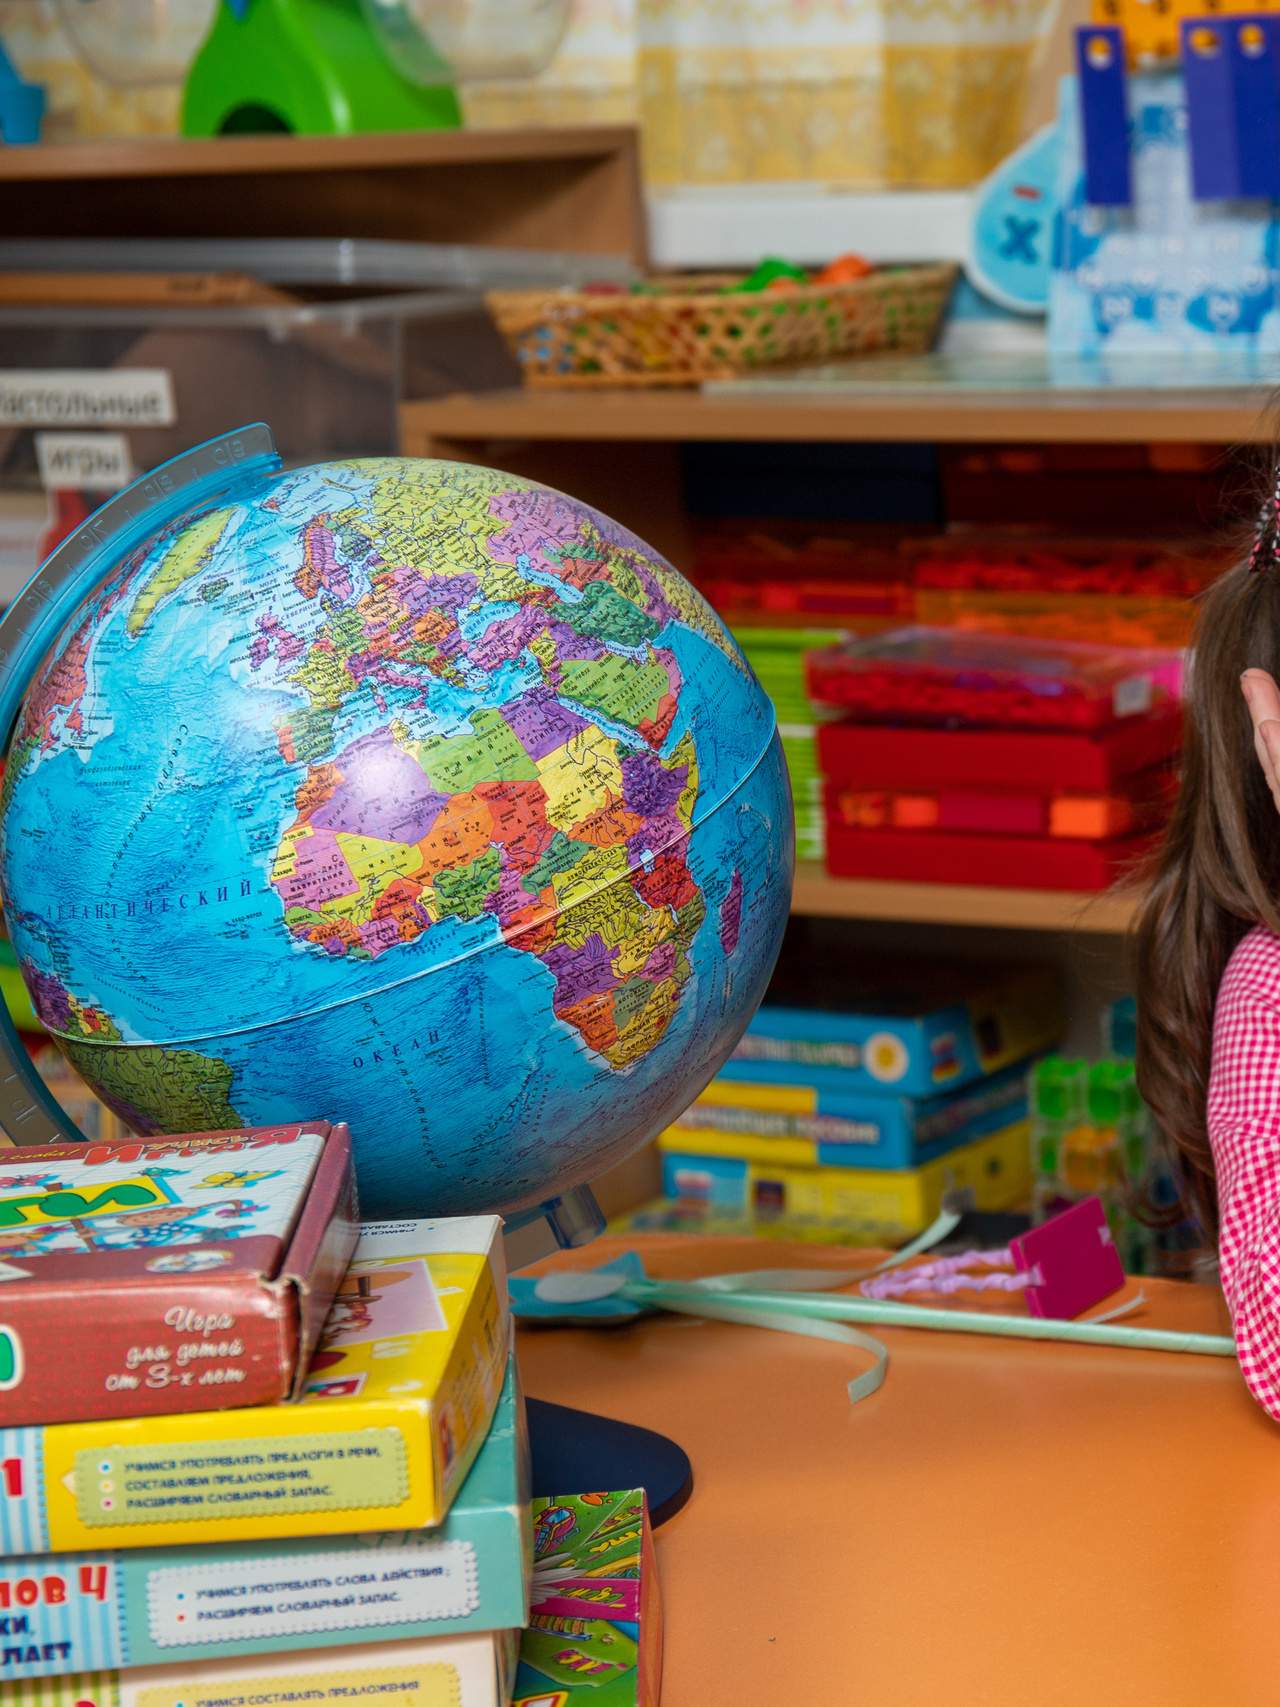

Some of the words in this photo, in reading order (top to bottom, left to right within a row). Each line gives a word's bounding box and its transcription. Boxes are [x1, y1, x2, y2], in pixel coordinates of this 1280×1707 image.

[0, 389, 159, 417] астольные
[289, 870, 344, 893] МАВРИТАНИЯ
[46, 878, 252, 920] АТЛАНТИЧЕСКИЙ
[352, 1029, 440, 1069] ОКЕАН
[164, 1305, 236, 1339] Игра
[126, 1345, 173, 1371] для
[175, 1337, 245, 1368] детей
[105, 1373, 141, 1392] от
[198, 1367, 248, 1386] лет
[124, 1459, 177, 1474] УЧИМСЯ
[178, 1454, 266, 1471] УПОТРЕБЛЯТЬ
[267, 1449, 335, 1465] ПРЕДЛОГИ
[125, 1475, 210, 1493] СОСТАВЛЯЕМ
[126, 1493, 205, 1511] РАСШИРЯЕМ
[207, 1486, 287, 1505] СЛОВАРНЫЙ
[78, 1565, 108, 1602] 4
[196, 1585, 248, 1601] УЧИМСЯ
[249, 1577, 333, 1596] УПОТРЕБЛЯТЬ
[335, 1573, 378, 1587] СЛОВА
[197, 1605, 274, 1622] РАСШИРЯЕМ
[277, 1595, 356, 1614] СЛОВАРНЫЙ
[247, 1688, 326, 1706] СОСТАВЛЯТЬ
[328, 1680, 420, 1699] ПРЕДЛОЖЕНИЯ
